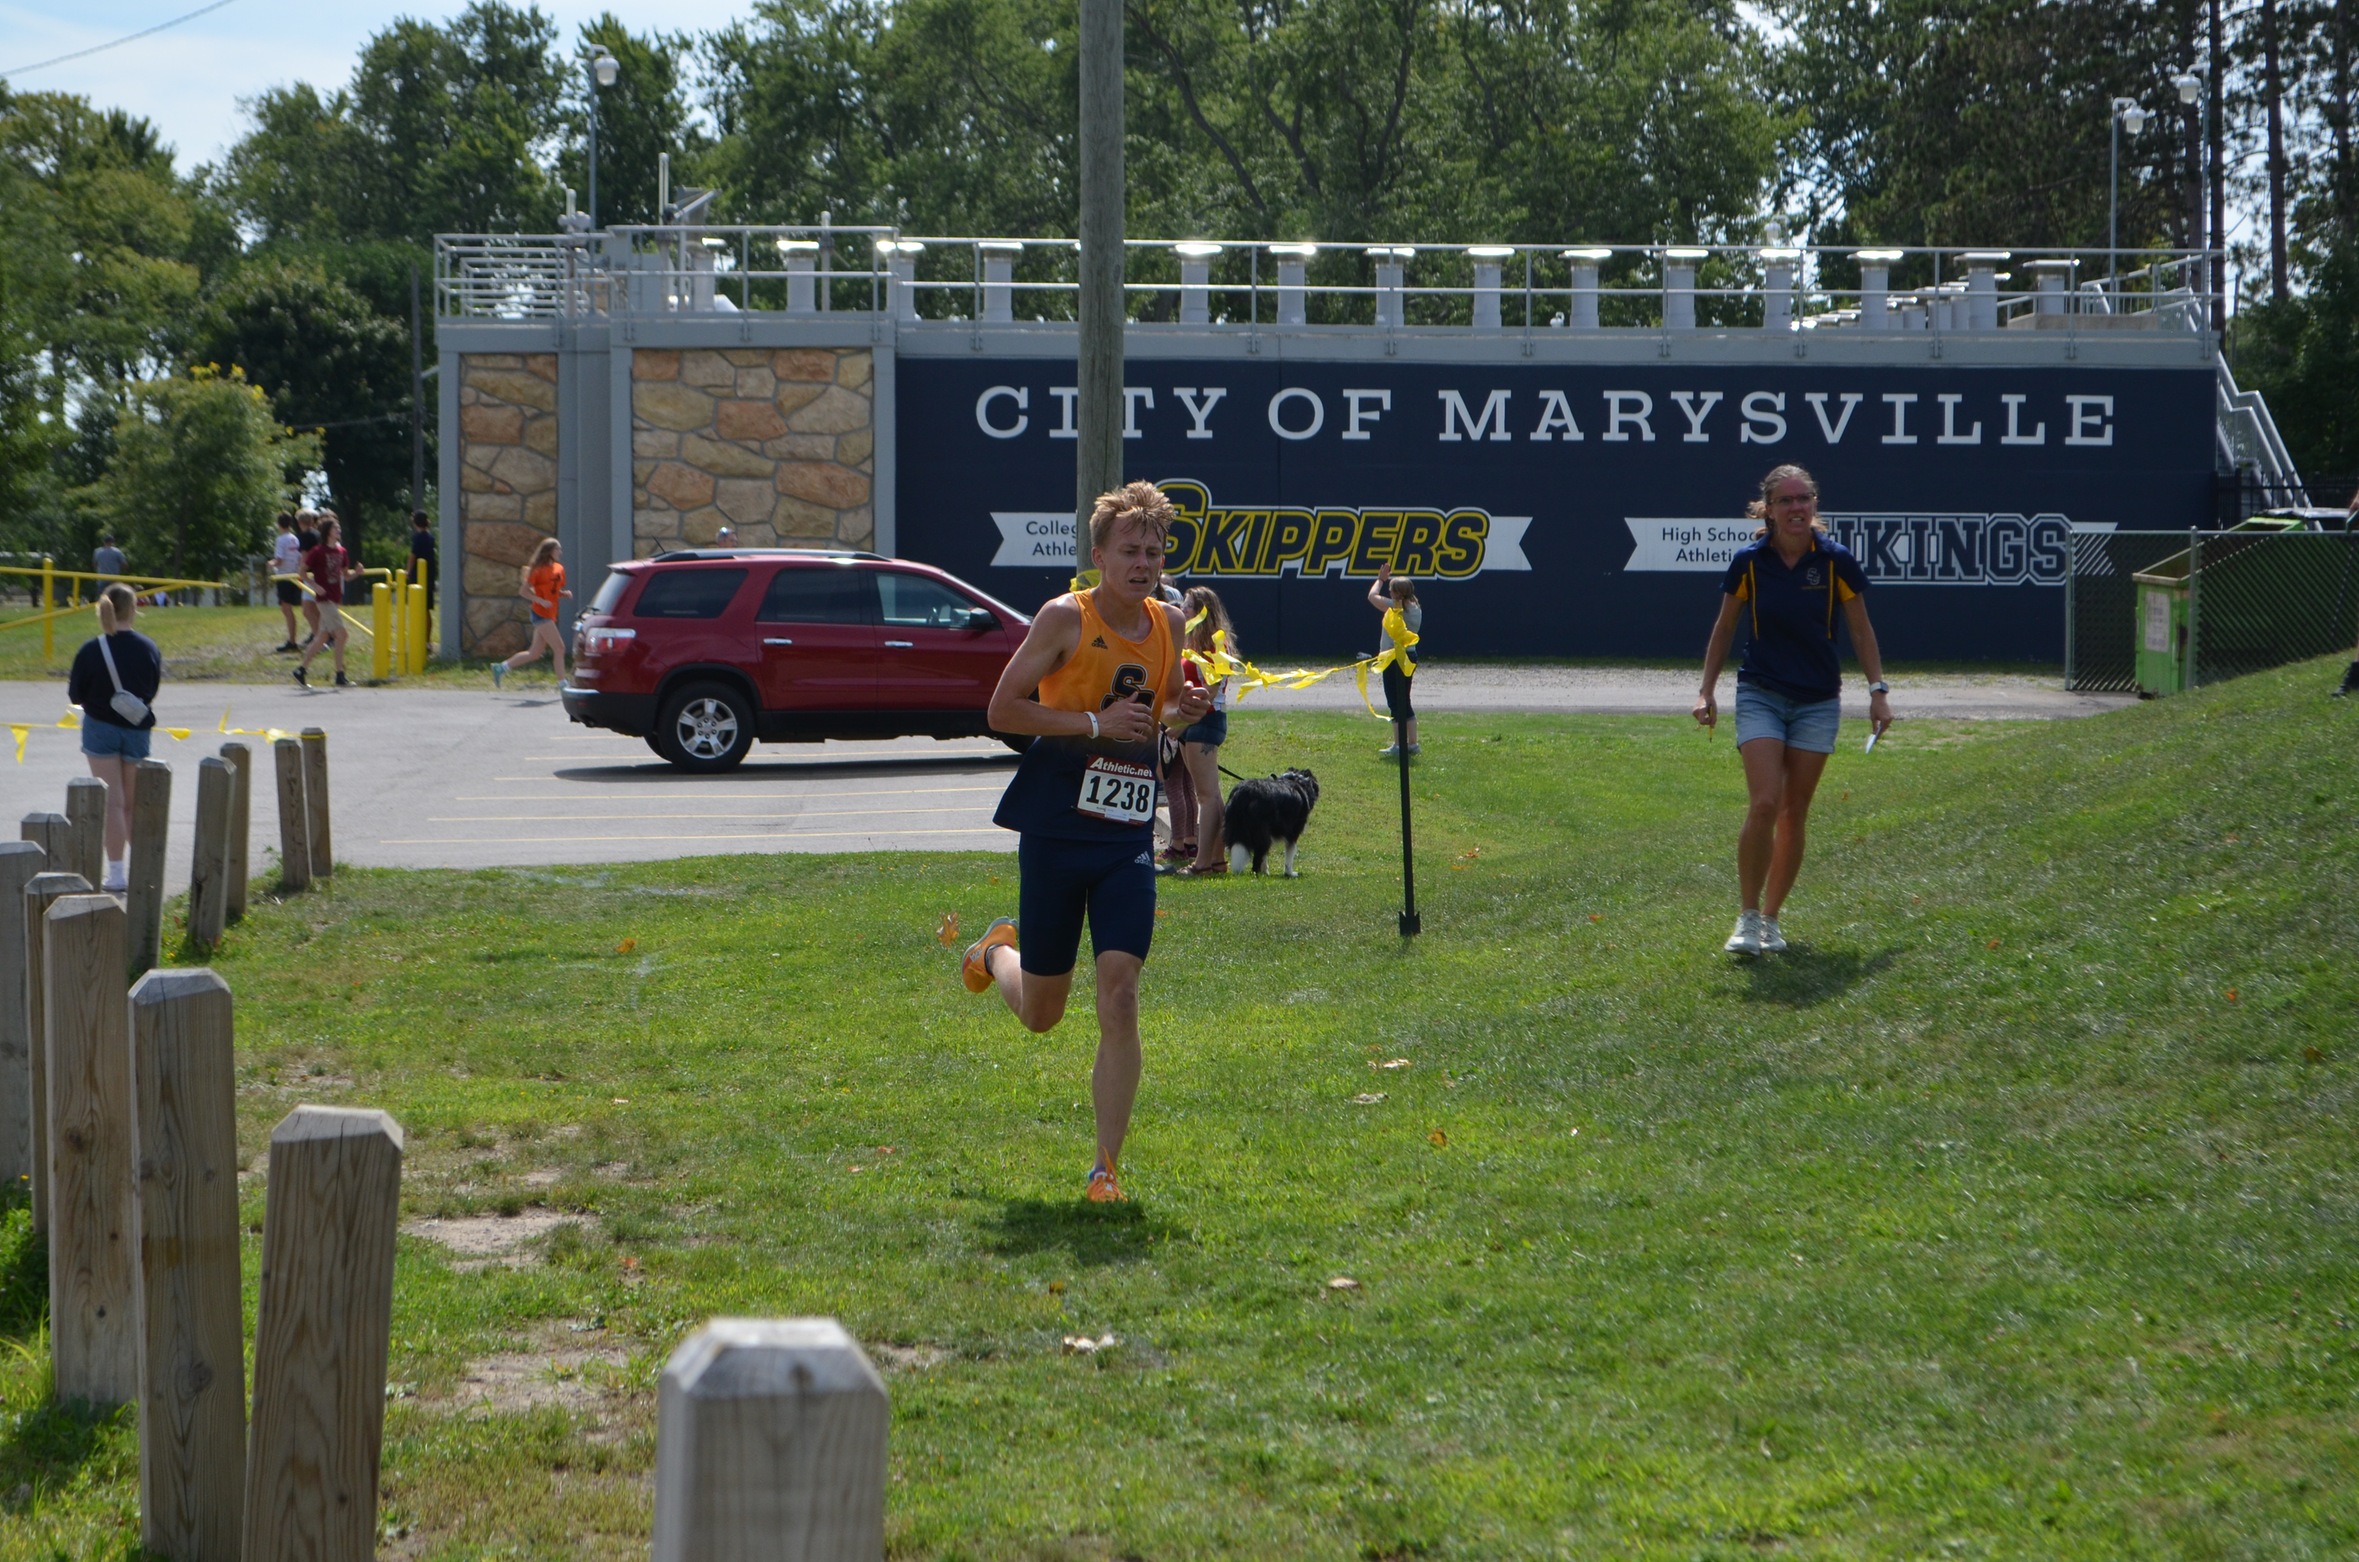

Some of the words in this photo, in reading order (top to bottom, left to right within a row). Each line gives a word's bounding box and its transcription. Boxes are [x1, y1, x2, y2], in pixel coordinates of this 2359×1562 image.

[975, 385, 1227, 439] CITY
[1267, 387, 1392, 441] OF
[1438, 389, 2115, 447] MARYSVILLE
[1155, 477, 1491, 581] SKIPPERS
[1662, 526, 1702, 546] High
[1032, 541, 1077, 556] Athle
[1675, 547, 1732, 563] Athleti
[1819, 511, 2073, 586] IKINGS
[1090, 757, 1152, 777] Athletic.net
[1086, 775, 1150, 813] 1238
